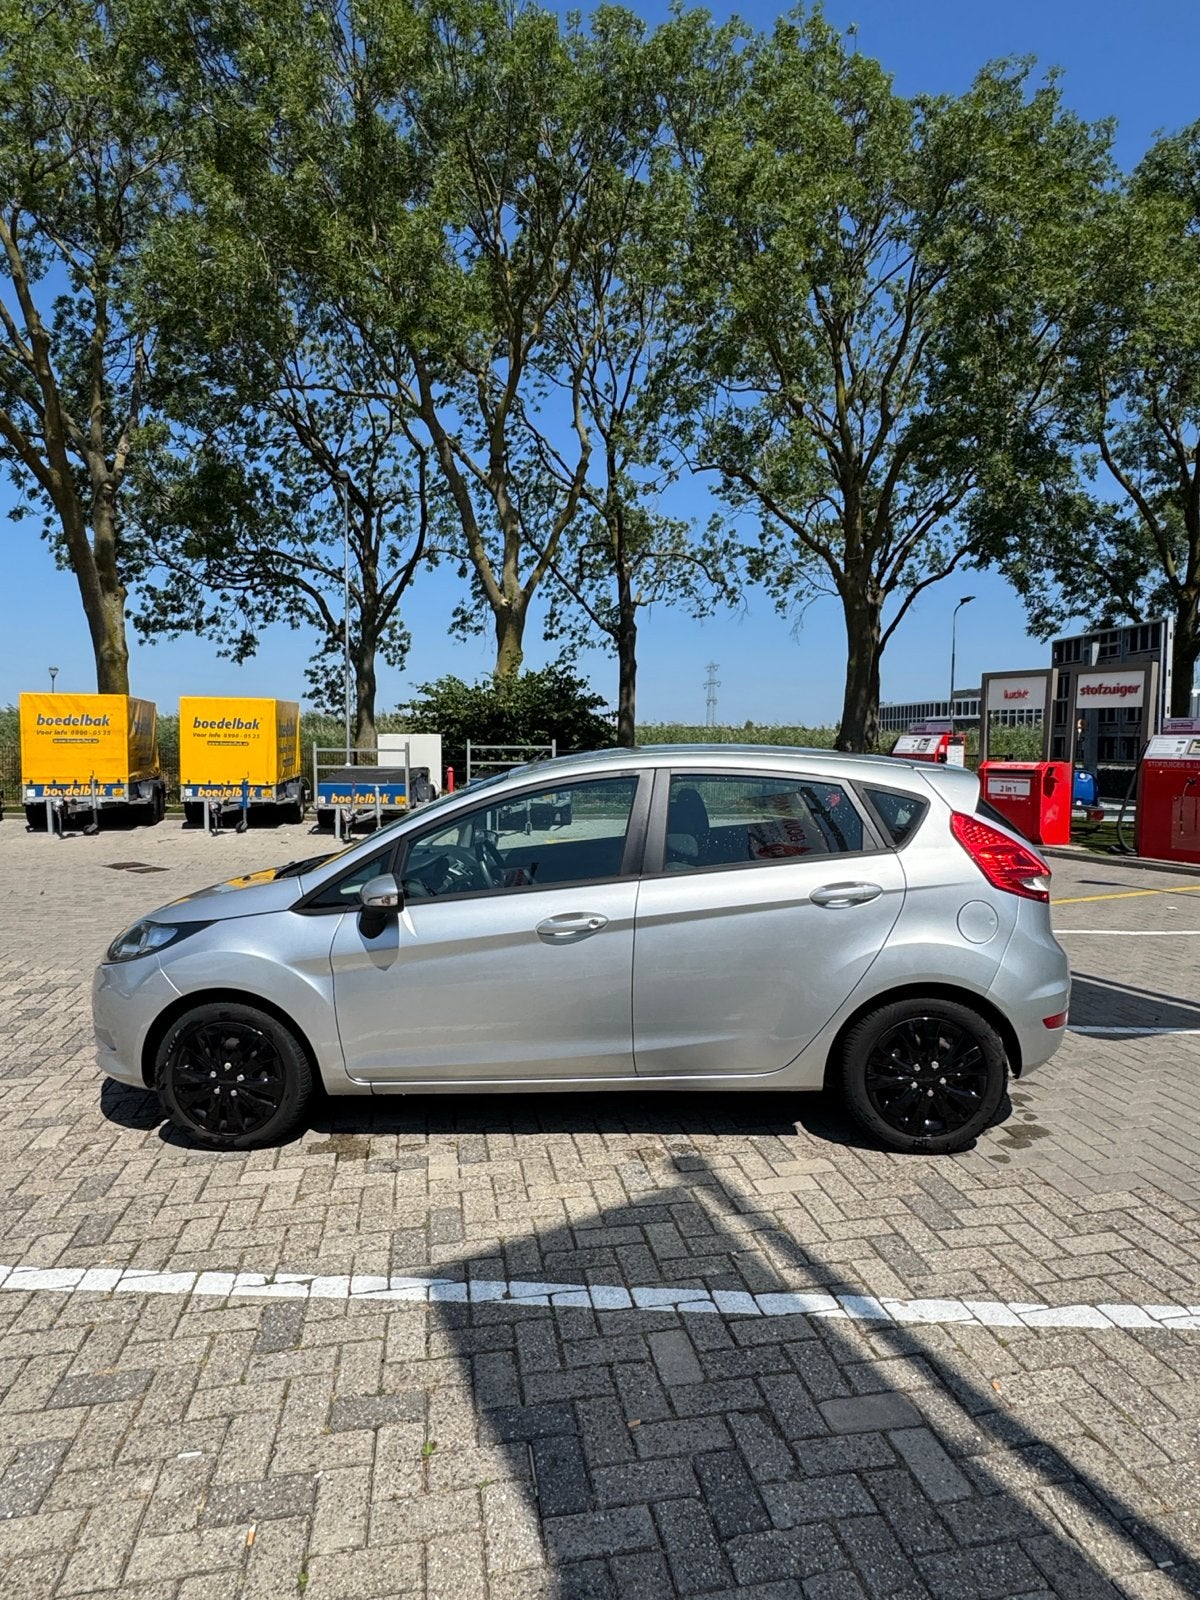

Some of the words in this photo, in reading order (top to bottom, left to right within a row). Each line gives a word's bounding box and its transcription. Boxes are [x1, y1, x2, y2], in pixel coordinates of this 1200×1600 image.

[1080, 682, 1141, 697] stofzuiger
[36, 713, 110, 726] boedelbak
[193, 716, 260, 729] boedelbak
[1005, 785, 1012, 793] in
